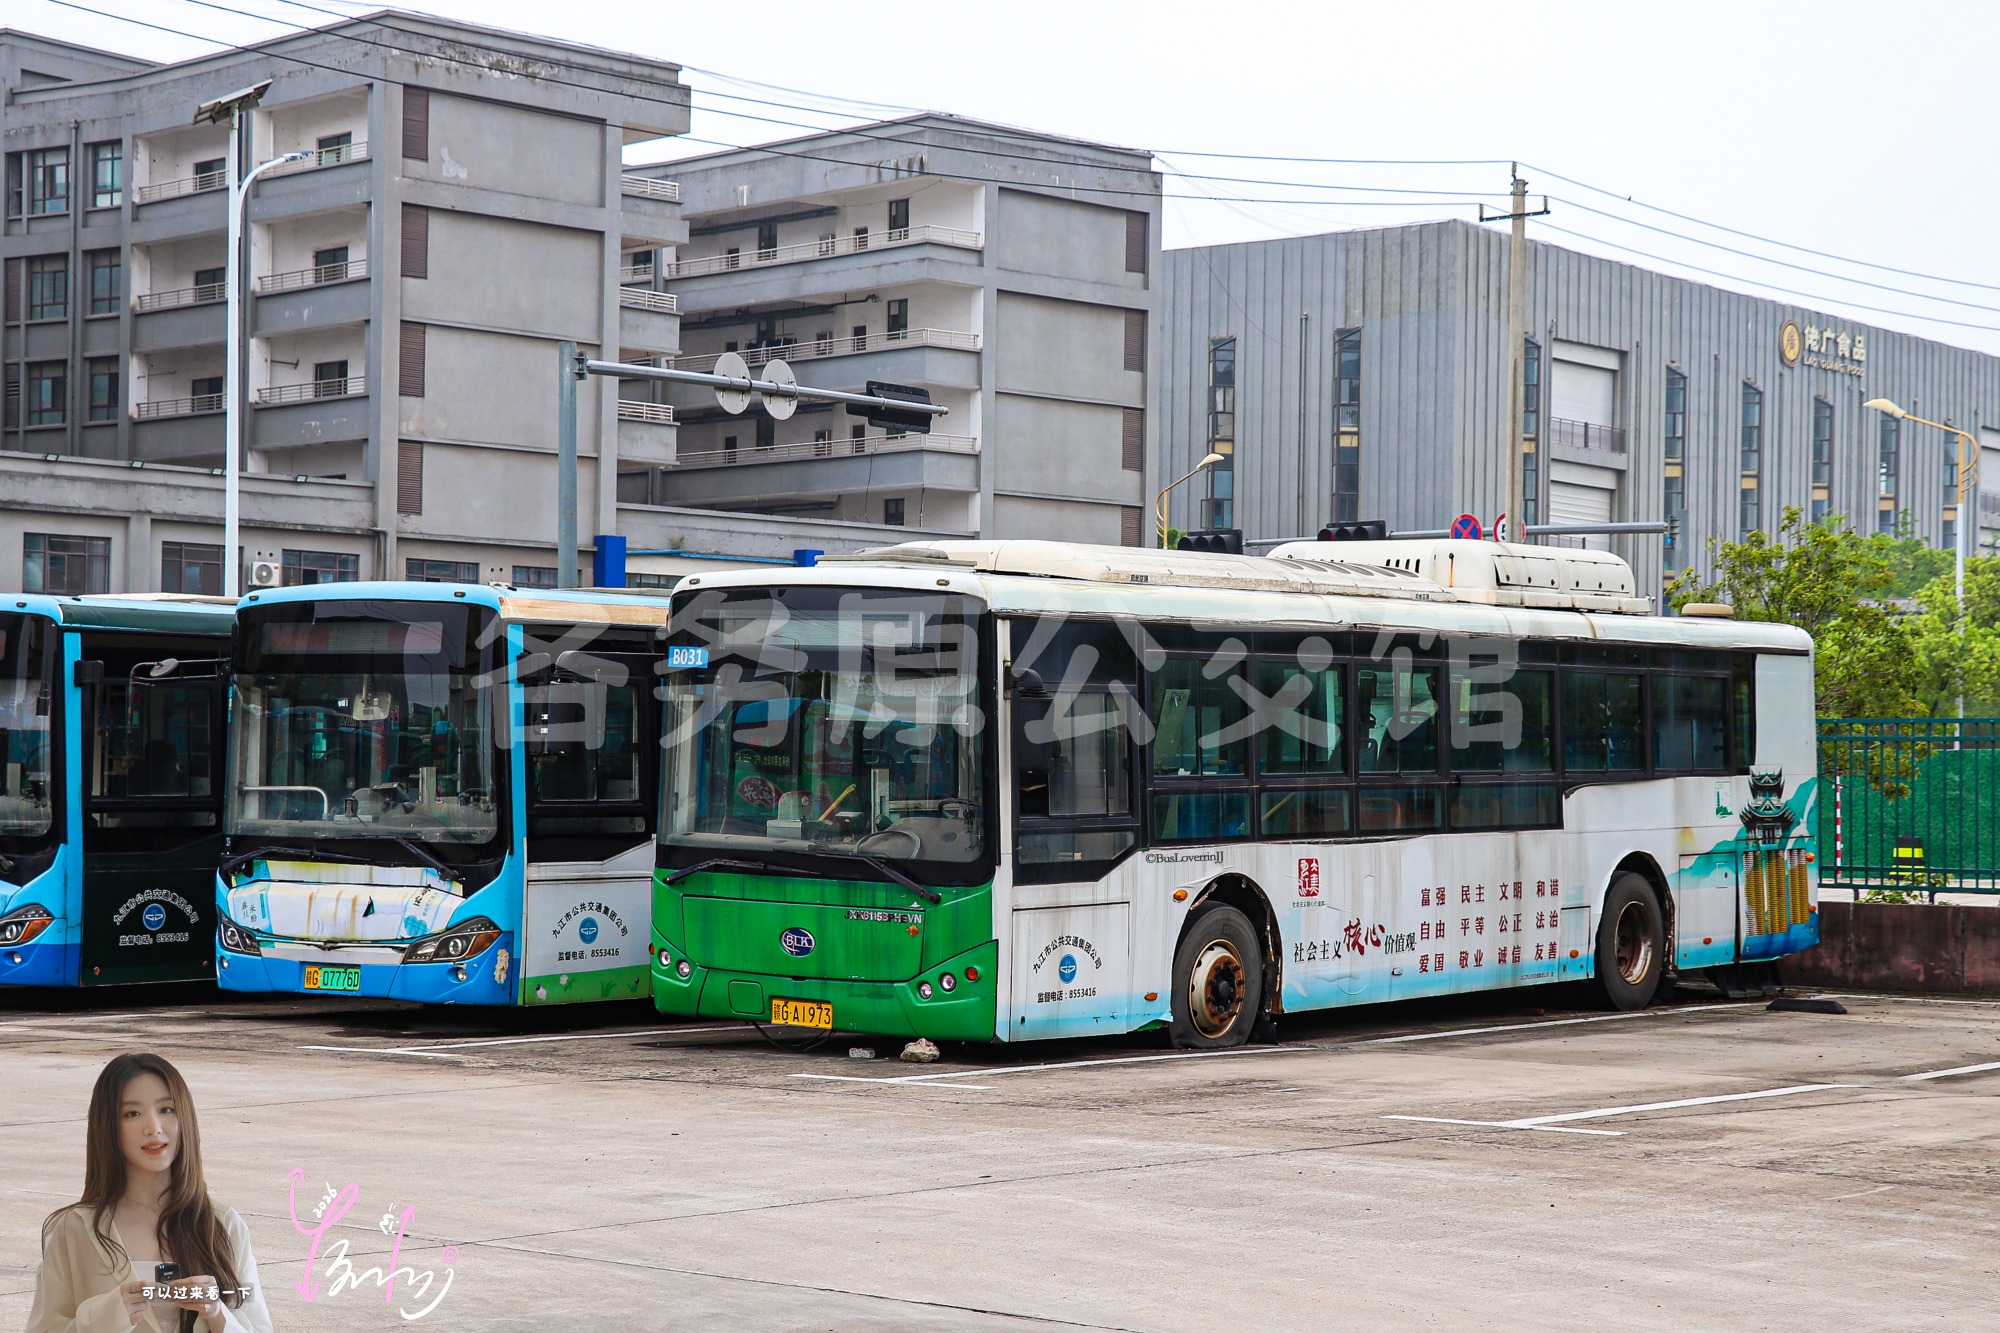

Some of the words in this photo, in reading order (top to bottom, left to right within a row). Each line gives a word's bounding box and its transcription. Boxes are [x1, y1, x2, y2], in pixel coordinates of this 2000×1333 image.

[673, 648, 703, 666] B031
[113, 888, 199, 925] 九江市公共交通集团公司
[1420, 886, 1446, 907] 富强
[1461, 884, 1485, 904] 民主
[1499, 881, 1522, 901] 文明
[1536, 879, 1559, 898] 和谐
[552, 901, 628, 938] 九江市公共交通集团公司
[1420, 920, 1446, 940] 自由
[1460, 916, 1485, 936] 平等
[1498, 913, 1522, 933] 公正
[1535, 910, 1559, 929] 法治
[785, 934, 811, 948] BLK
[1033, 935, 1102, 973] 九江市公共交通集团公司
[1418, 953, 1445, 973] 爱国
[1459, 949, 1484, 969] 敬业
[1497, 945, 1521, 965] 诚信
[1534, 941, 1558, 960] 友善
